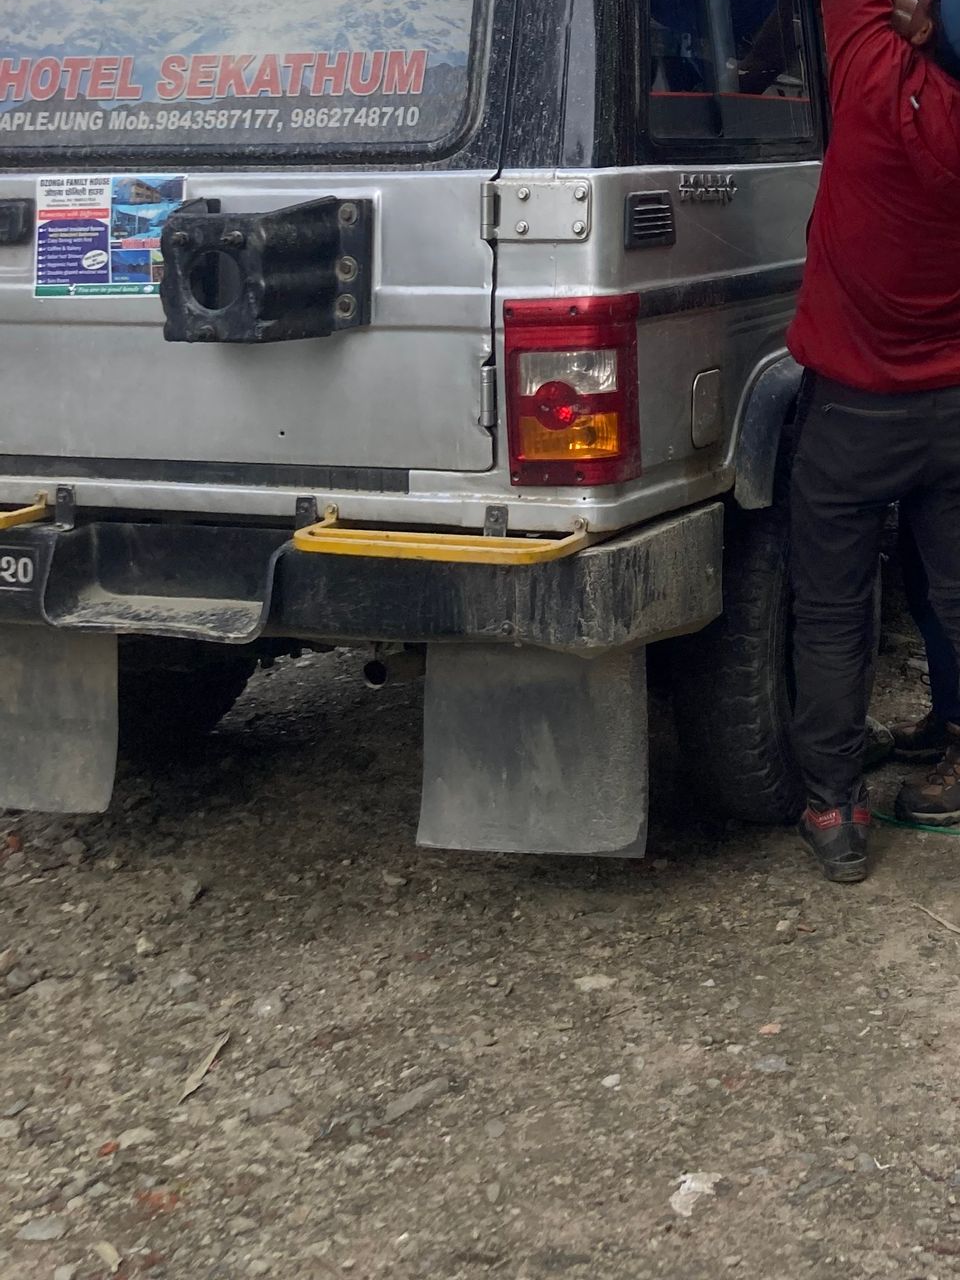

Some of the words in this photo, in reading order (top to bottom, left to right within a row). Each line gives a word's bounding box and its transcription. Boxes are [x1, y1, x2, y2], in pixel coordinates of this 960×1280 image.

[0, 55, 143, 101] HOTEL
[156, 49, 429, 100] SEKATHUM
[0, 111, 103, 131] APLEJUNG
[290, 107, 419, 128] 9862748710
